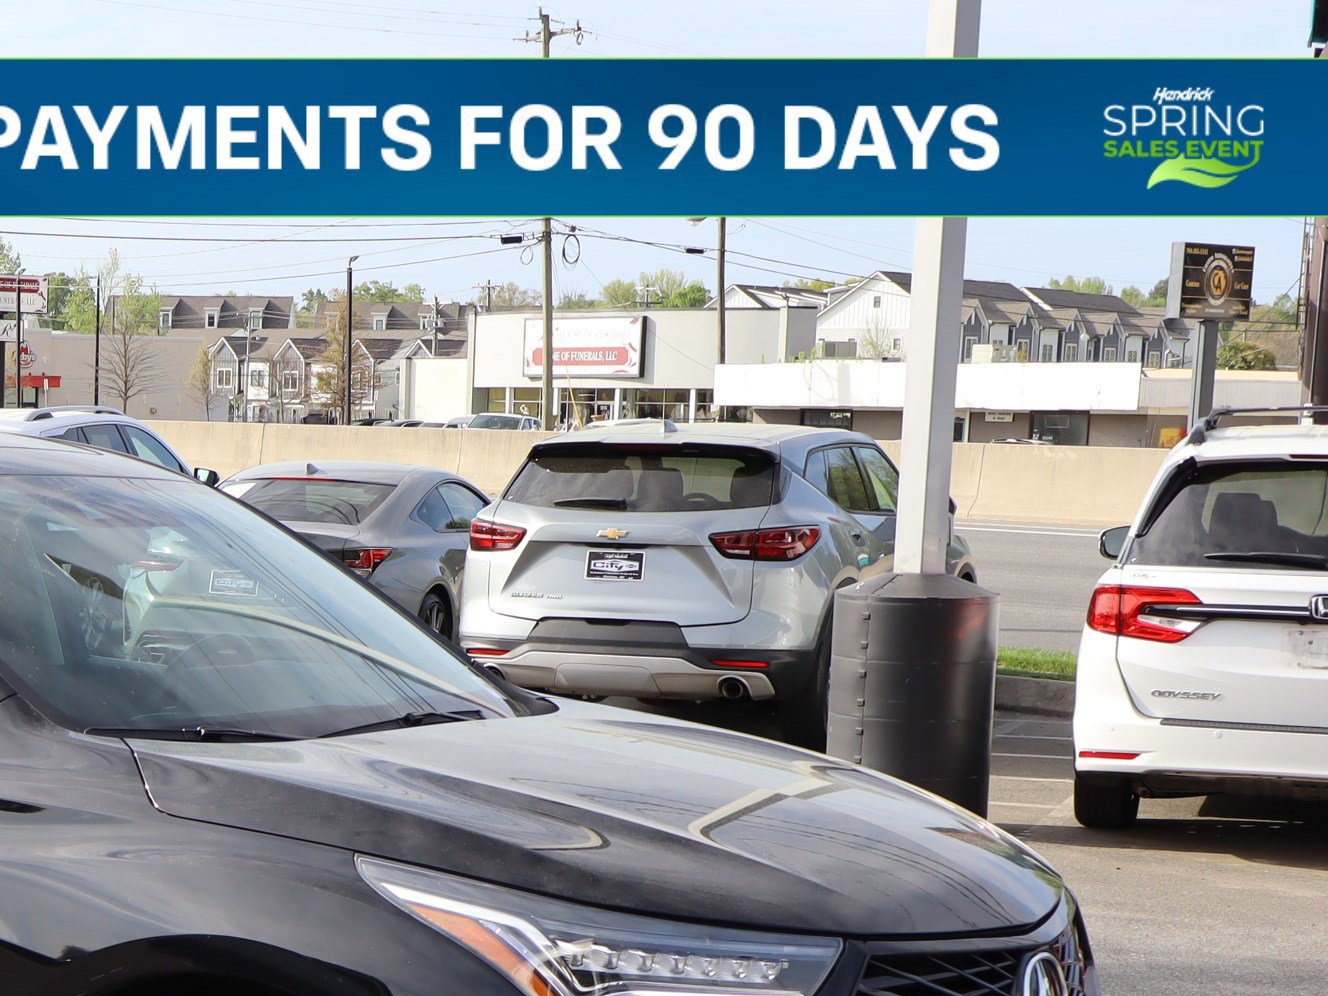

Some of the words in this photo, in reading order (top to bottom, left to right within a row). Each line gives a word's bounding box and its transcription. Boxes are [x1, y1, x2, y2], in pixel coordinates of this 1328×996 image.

[561, 351, 570, 361] OF
[605, 350, 618, 361] LLC
[1150, 689, 1222, 700] ODYSSEY
